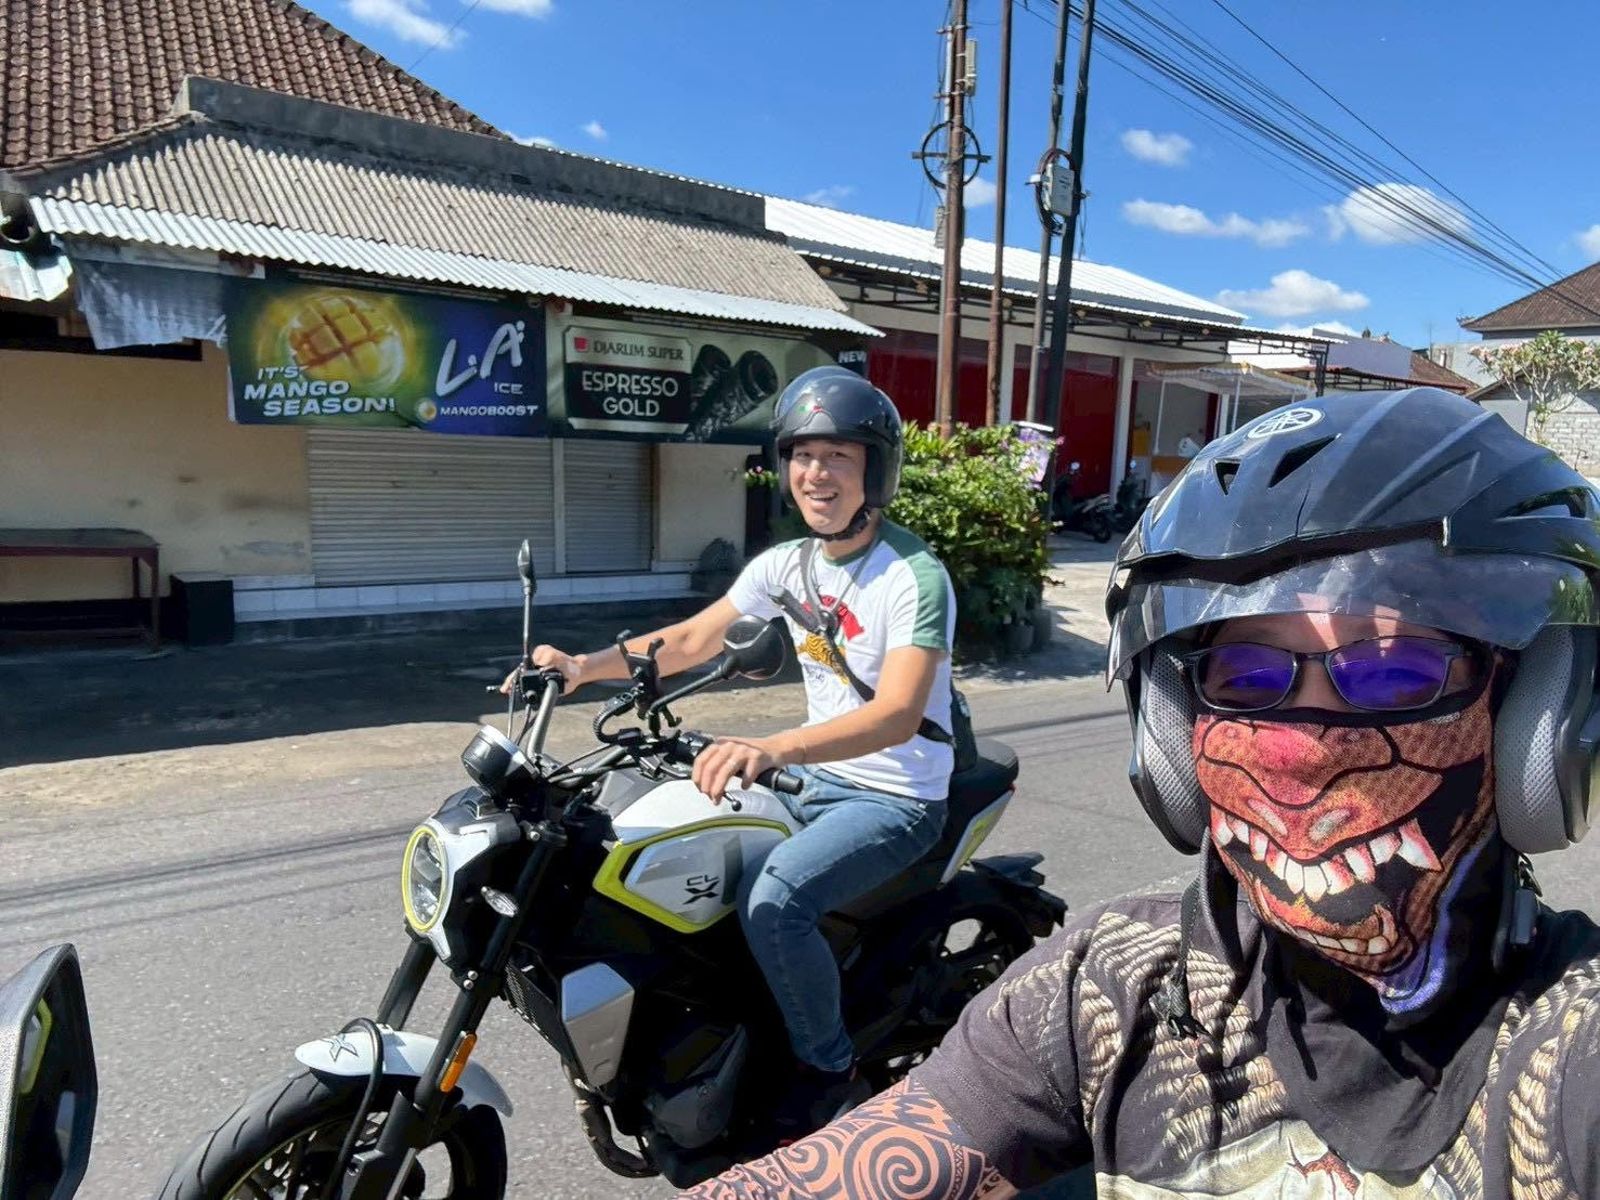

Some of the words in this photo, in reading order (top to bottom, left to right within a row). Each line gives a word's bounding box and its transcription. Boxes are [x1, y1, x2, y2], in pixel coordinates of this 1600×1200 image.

[593, 339, 645, 358] DJARUM
[647, 346, 684, 360] SUPER
[257, 366, 299, 380] IT'S
[243, 380, 350, 400] MANGO
[494, 382, 524, 395] ICE
[582, 370, 679, 397] ESPRESSO
[262, 397, 395, 417] SEASON!
[440, 404, 539, 417] MANGOBOOST
[602, 397, 661, 417] GOLD
